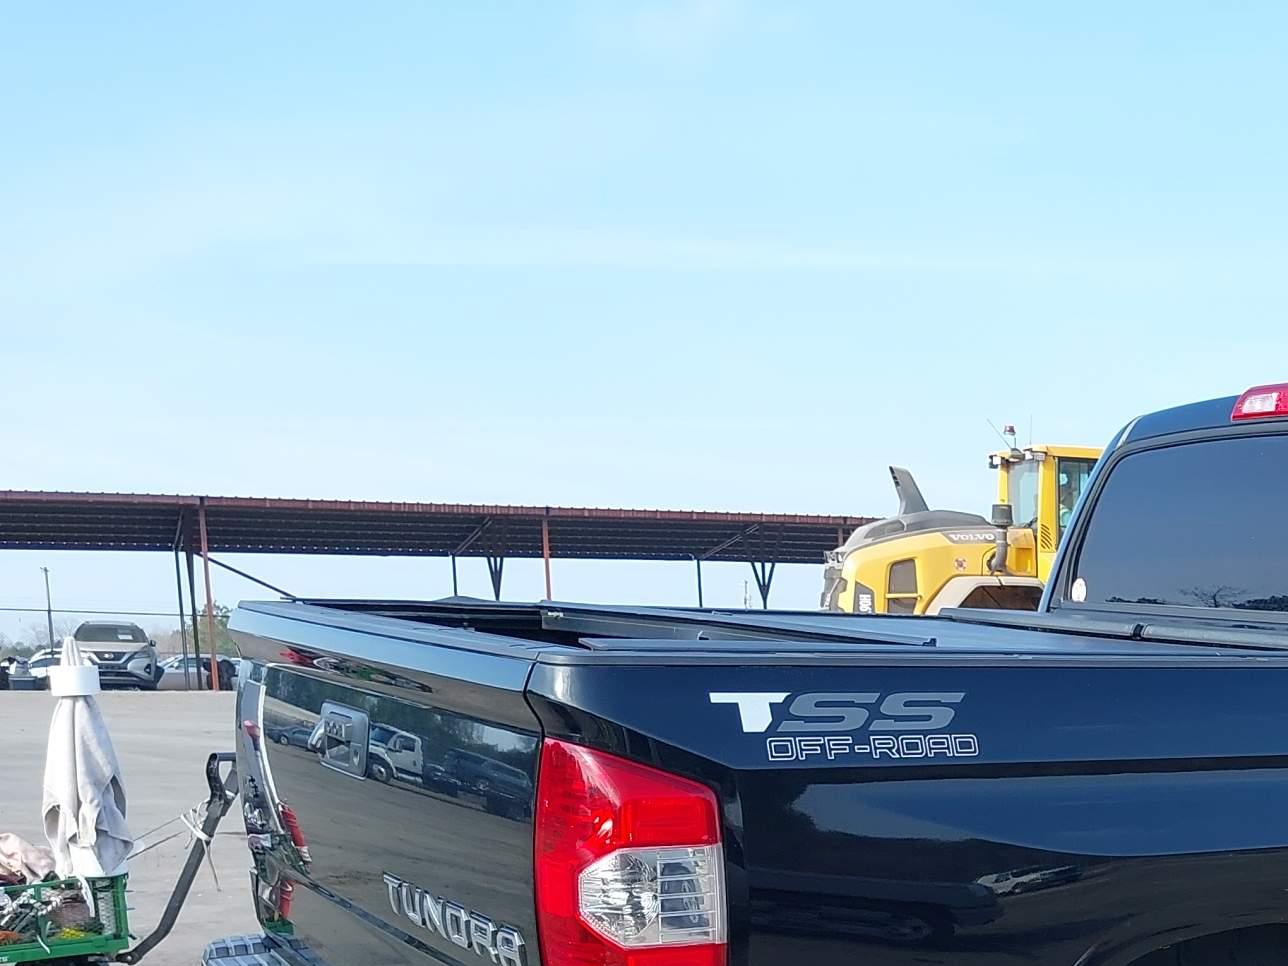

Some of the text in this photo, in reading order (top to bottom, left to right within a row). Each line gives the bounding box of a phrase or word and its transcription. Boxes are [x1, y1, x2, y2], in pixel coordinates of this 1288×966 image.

[949, 533, 995, 541] VOLVO
[709, 692, 966, 732] TSS
[766, 734, 979, 761] OFF-ROAD
